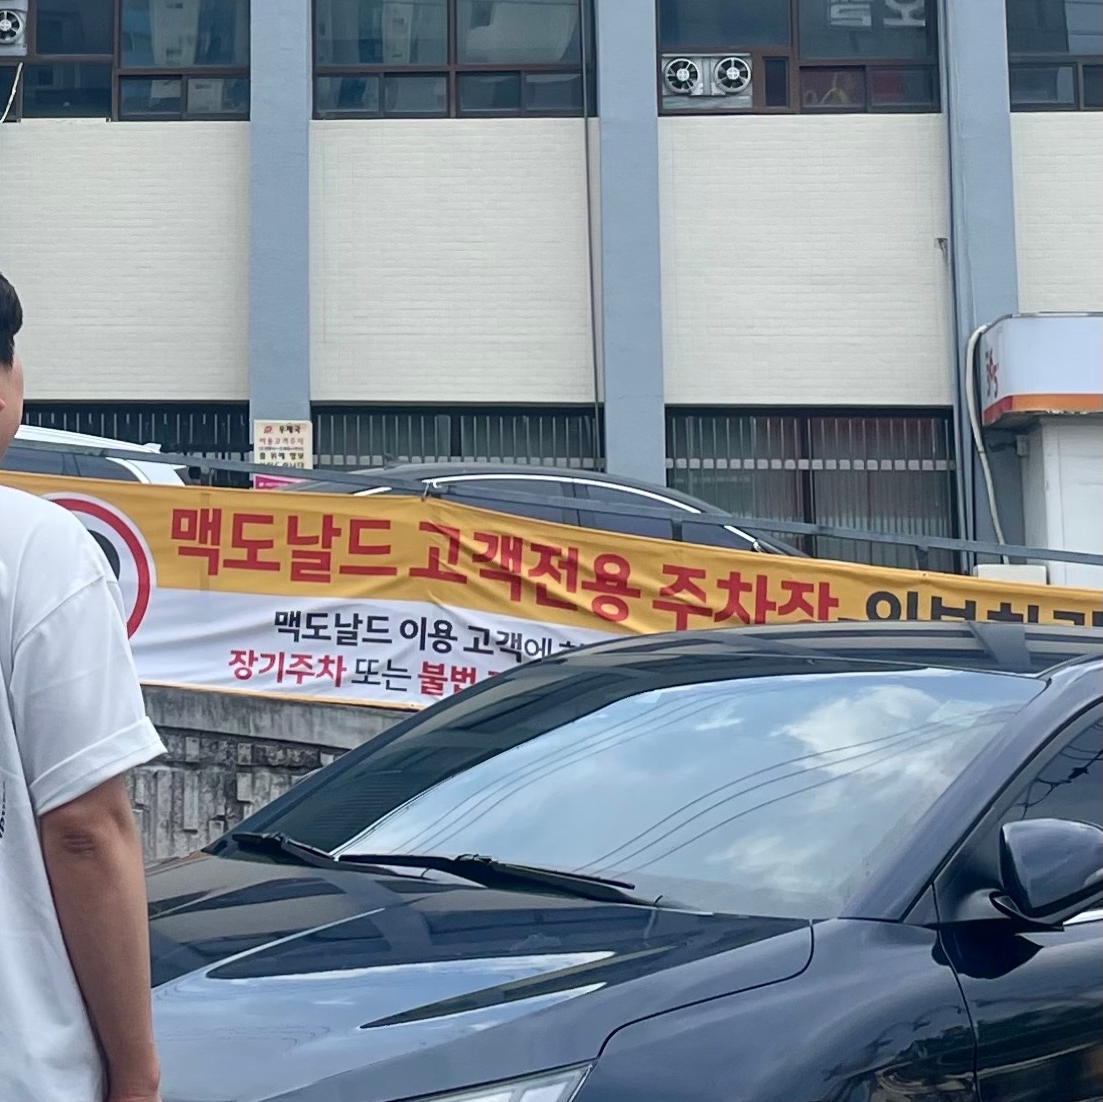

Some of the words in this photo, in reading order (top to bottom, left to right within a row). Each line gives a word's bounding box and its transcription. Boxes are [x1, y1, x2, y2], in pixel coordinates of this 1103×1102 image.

[171, 508, 397, 583] 맥도날드
[409, 521, 641, 623] 고객전용
[274, 610, 393, 645] 맥도날드
[400, 617, 458, 654] 이용
[462, 624, 552, 663] 고객에
[228, 650, 347, 688] 장기주차
[351, 659, 412, 691] 또는
[417, 661, 477, 697] 불법
